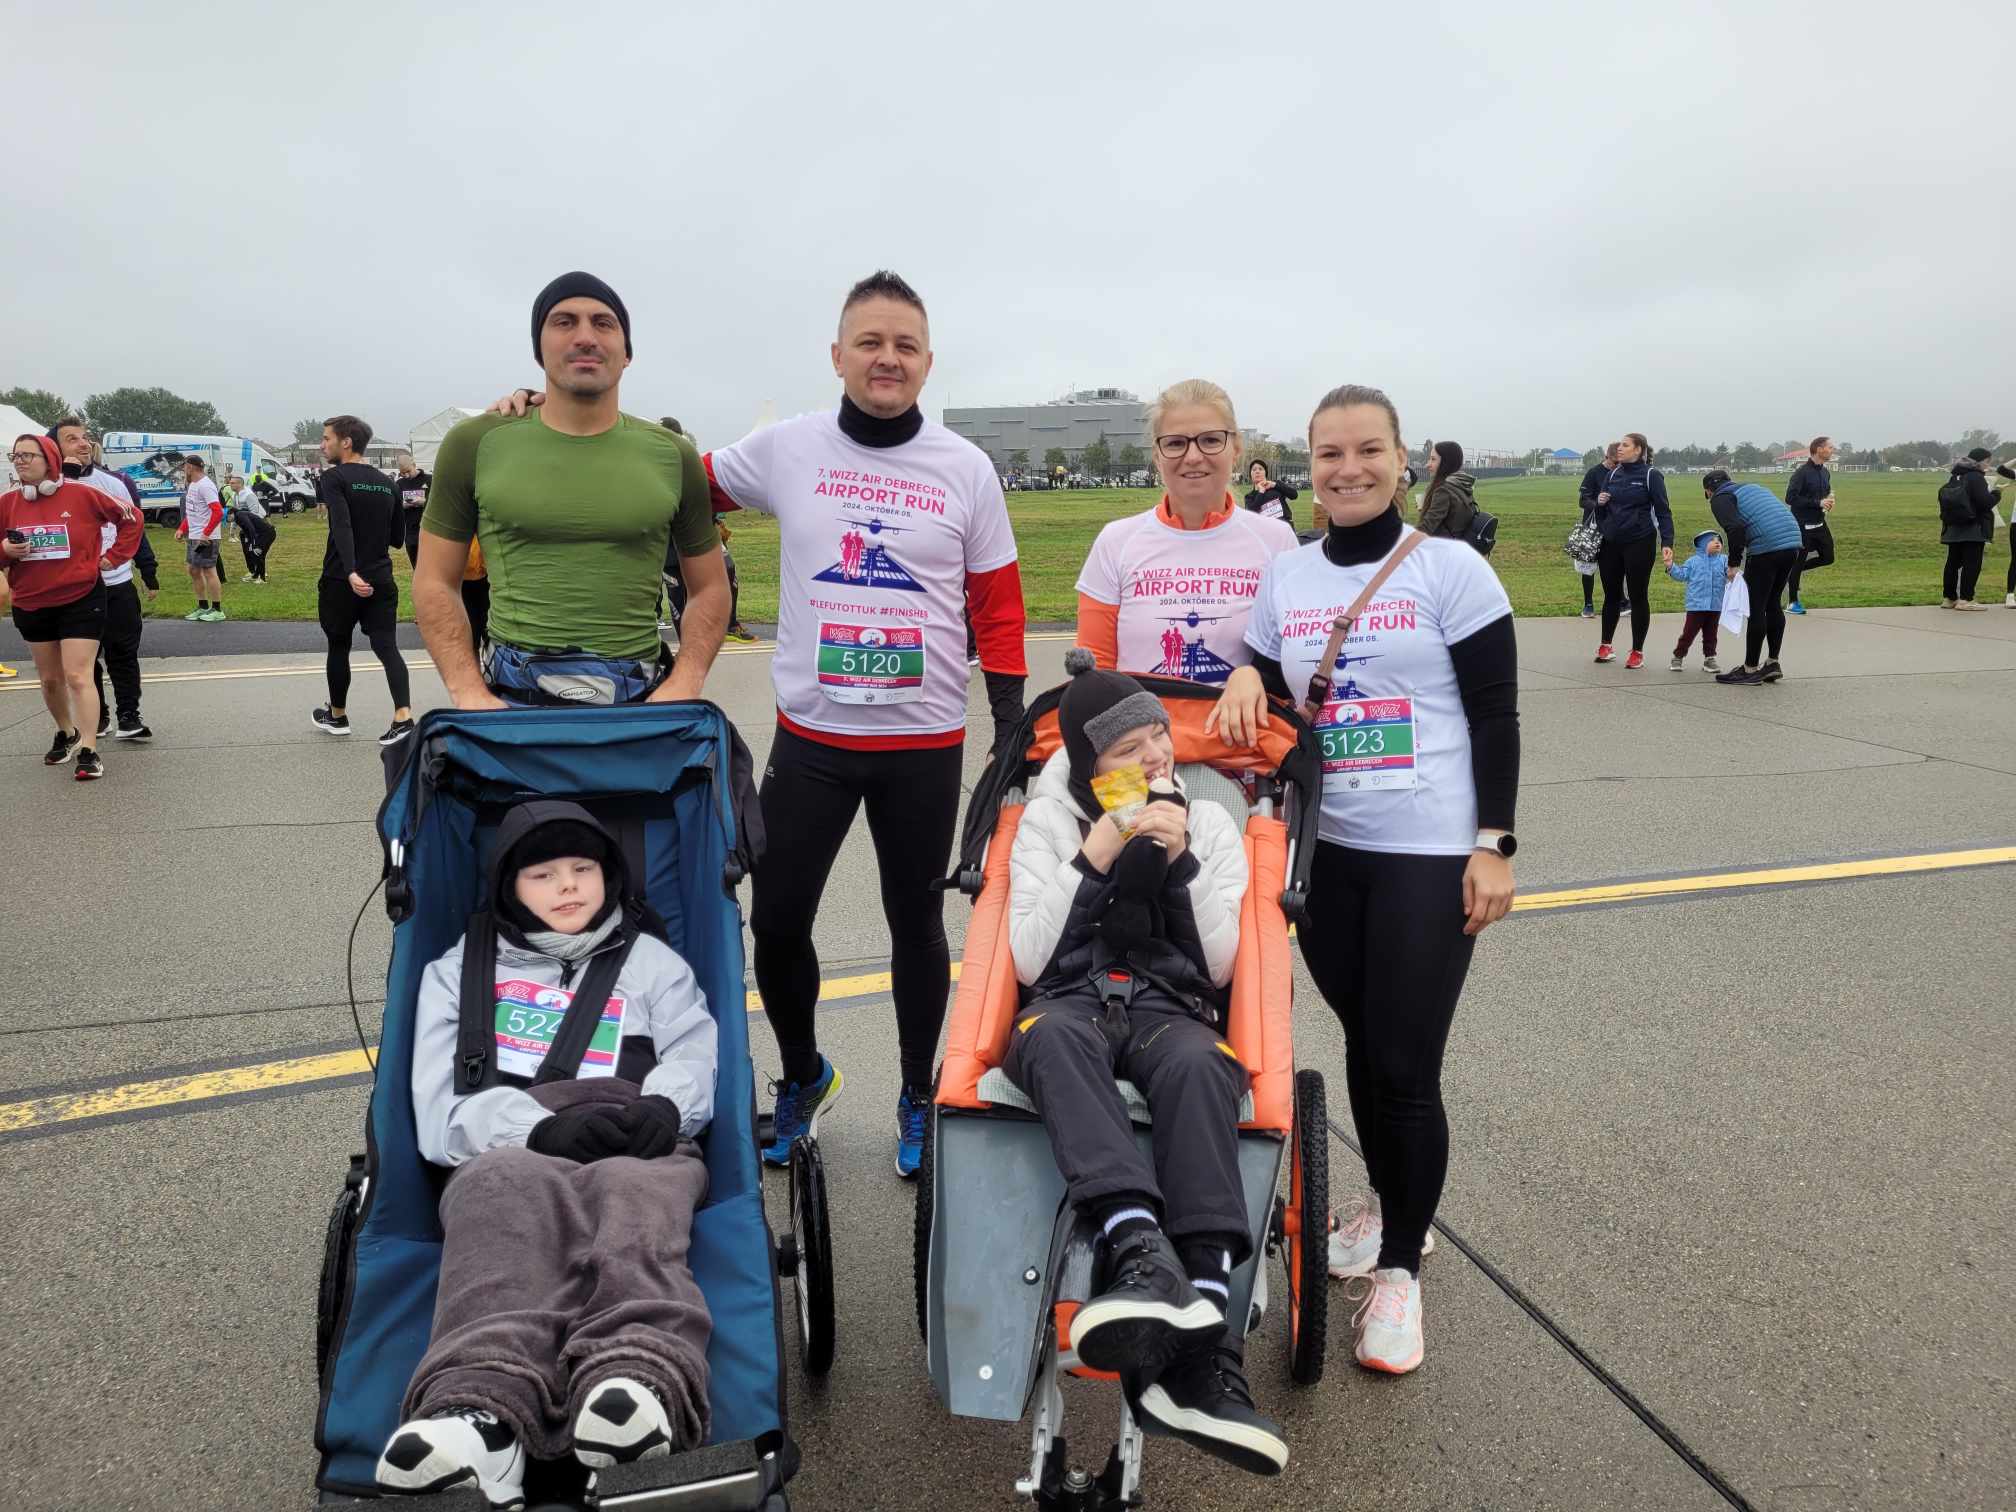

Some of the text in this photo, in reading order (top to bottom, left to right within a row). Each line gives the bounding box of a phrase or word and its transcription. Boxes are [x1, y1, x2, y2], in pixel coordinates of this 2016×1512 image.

[817, 468, 946, 498] 7. WIZZ AIR DEBRECEN
[814, 480, 945, 515] AIRPORT RUN
[1143, 568, 1172, 578] WIZZ
[1175, 567, 1195, 577] AIR
[1198, 567, 1260, 580] DEBRECEN
[1134, 580, 1258, 598] AIRPORT RUN
[809, 599, 876, 615] #LEFUTOTTUK
[1292, 608, 1322, 619] WIZZ
[1325, 606, 1345, 617] AIR
[1283, 614, 1416, 638] AIRPOT RUN
[842, 651, 901, 674] 5120
[1322, 729, 1385, 757] 5123
